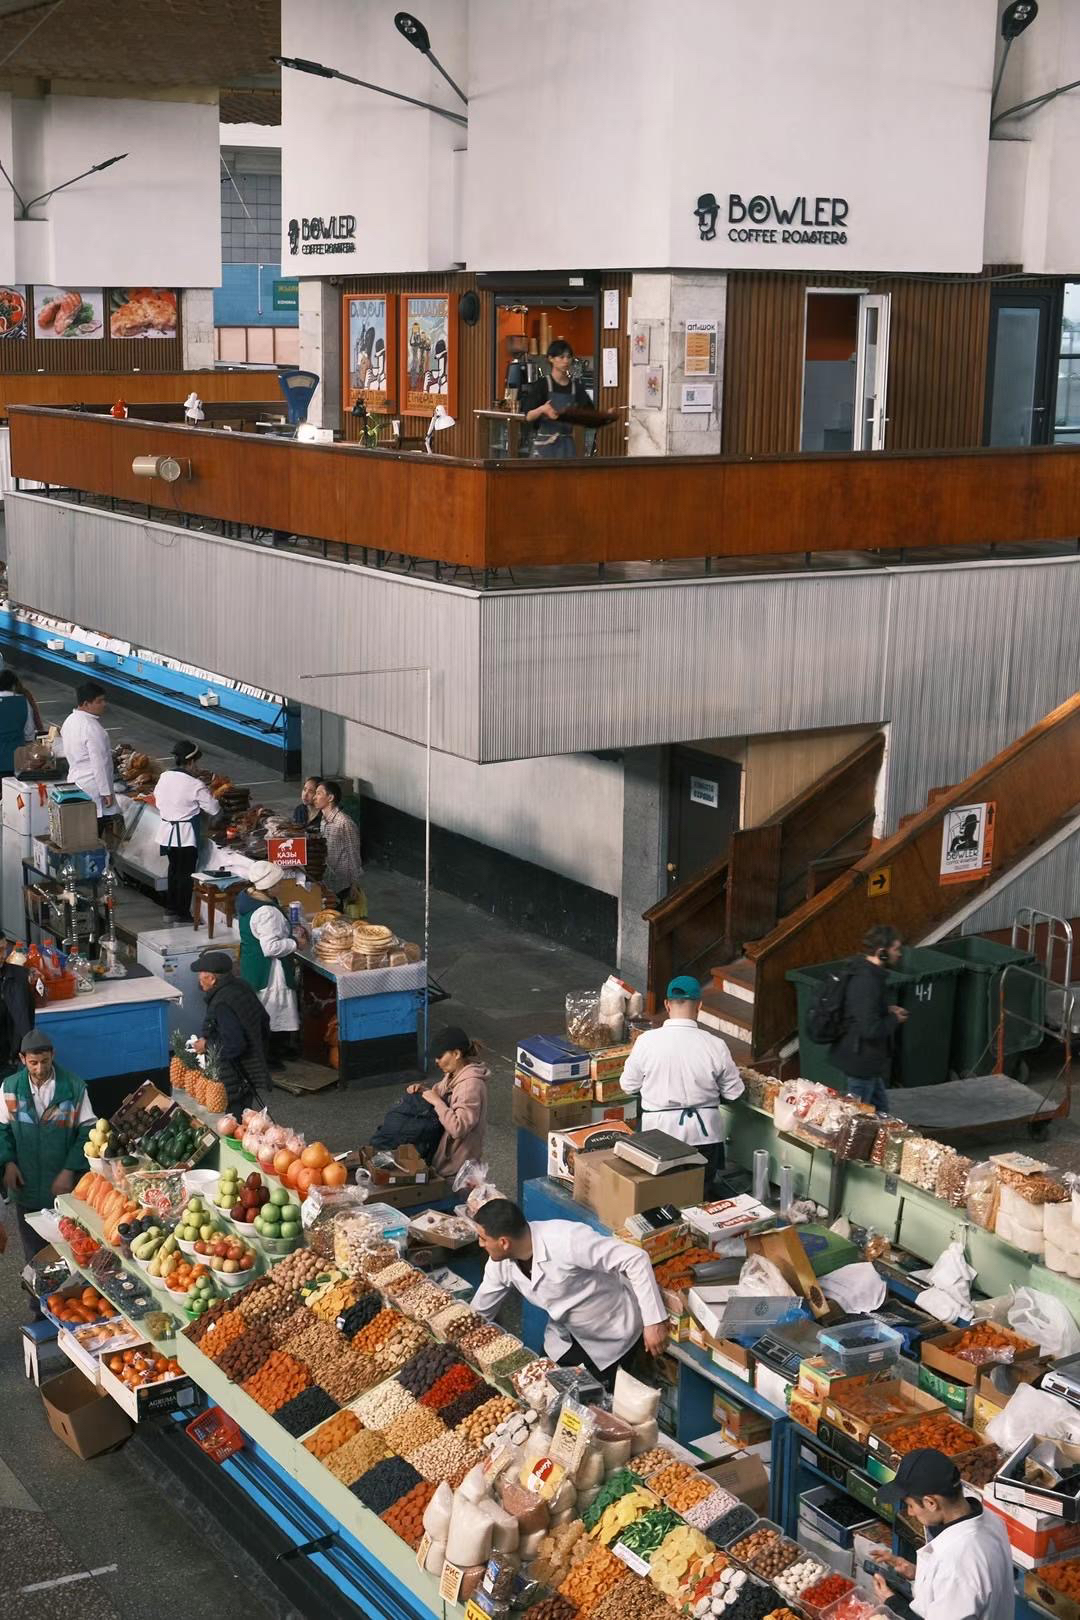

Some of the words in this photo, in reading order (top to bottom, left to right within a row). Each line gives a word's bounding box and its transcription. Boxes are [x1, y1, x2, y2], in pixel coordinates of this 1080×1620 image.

[728, 194, 849, 226] BOWLER
[302, 215, 356, 240] BOWLER
[728, 228, 777, 243] COFFEE
[782, 229, 848, 244] ROASTERS
[946, 849, 979, 861] BOWLER
[445, 1563, 461, 1580] РИС
